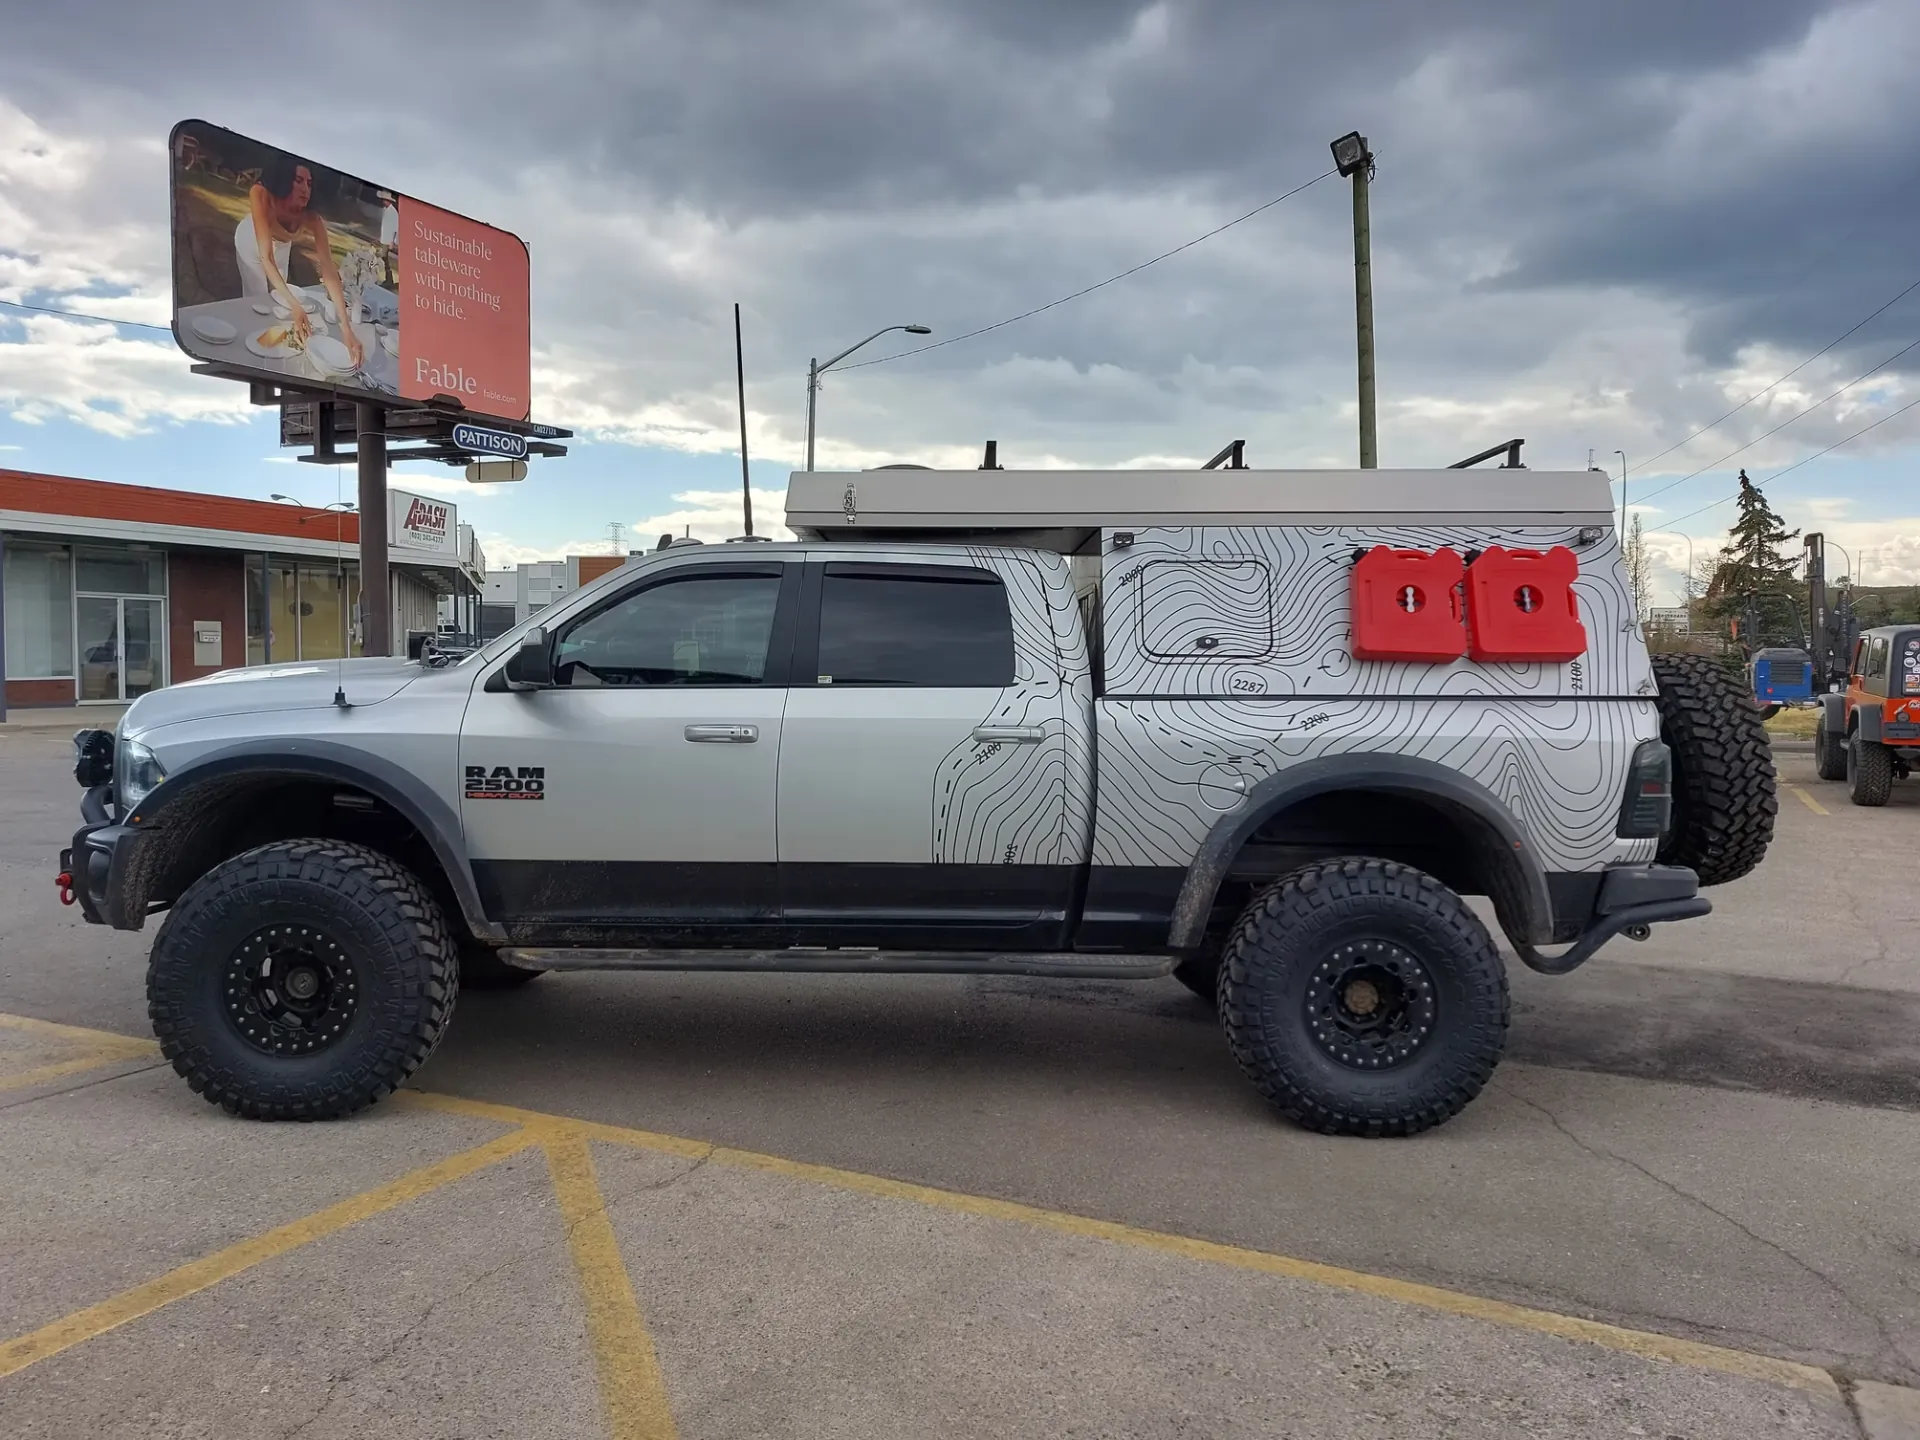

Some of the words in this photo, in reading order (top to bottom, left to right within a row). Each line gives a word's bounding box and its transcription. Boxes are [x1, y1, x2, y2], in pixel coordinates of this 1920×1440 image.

[414, 220, 492, 260] Sustainable
[414, 246, 481, 280] tableware
[414, 271, 445, 292] with
[449, 283, 501, 312] nothing
[415, 294, 430, 310] to
[433, 295, 467, 321] hide.
[415, 357, 477, 395] Fable
[483, 388, 517, 404] fable.com
[459, 429, 521, 453] PATTISON
[1118, 564, 1143, 587] 2000
[1233, 678, 1264, 694] 2287
[1570, 662, 1583, 691] 2100
[1300, 712, 1330, 731] 2200
[975, 742, 1001, 765] 2100
[465, 766, 544, 779] RAM
[465, 779, 544, 791] 2500
